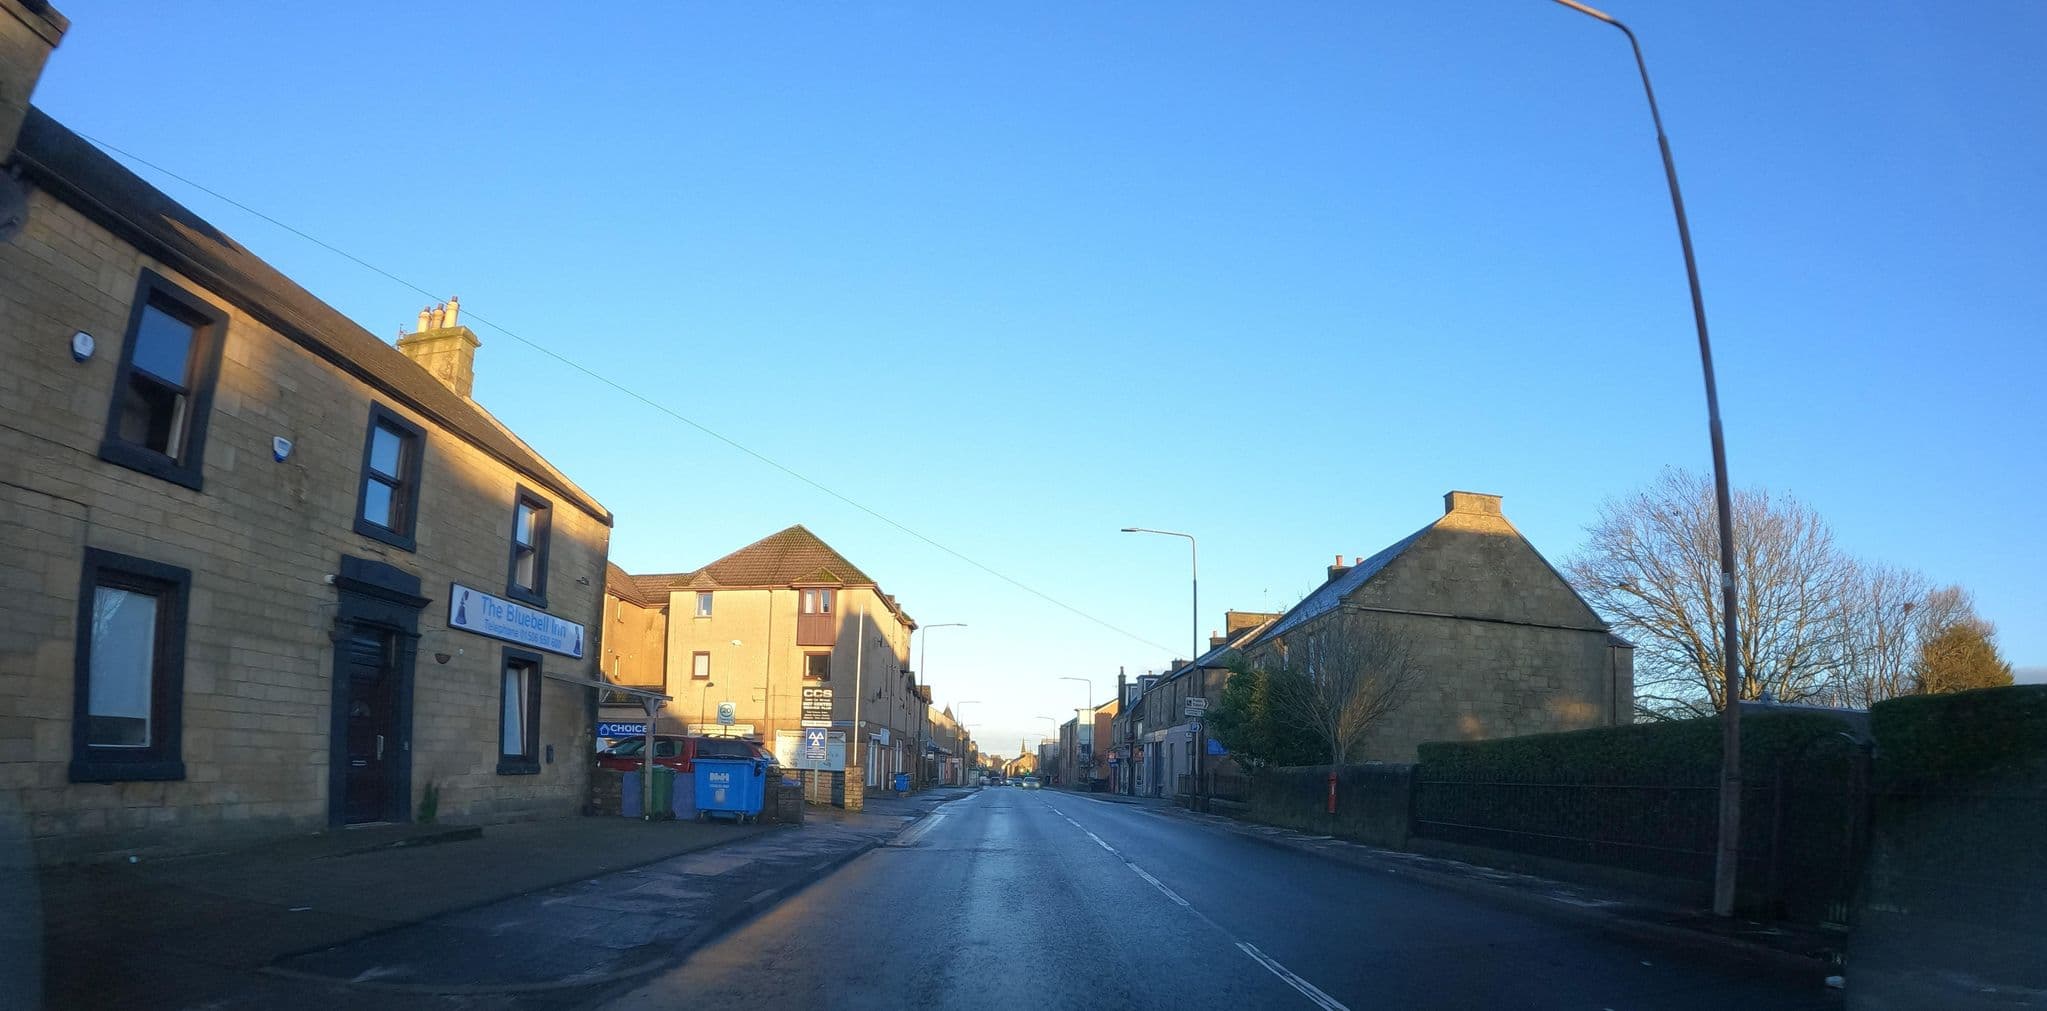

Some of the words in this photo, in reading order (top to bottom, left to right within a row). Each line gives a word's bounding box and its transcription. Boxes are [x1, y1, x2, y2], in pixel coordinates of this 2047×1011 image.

[481, 596, 503, 619] The
[507, 604, 548, 633] Bluebell
[552, 616, 567, 637] Inn
[803, 689, 833, 698] CCS
